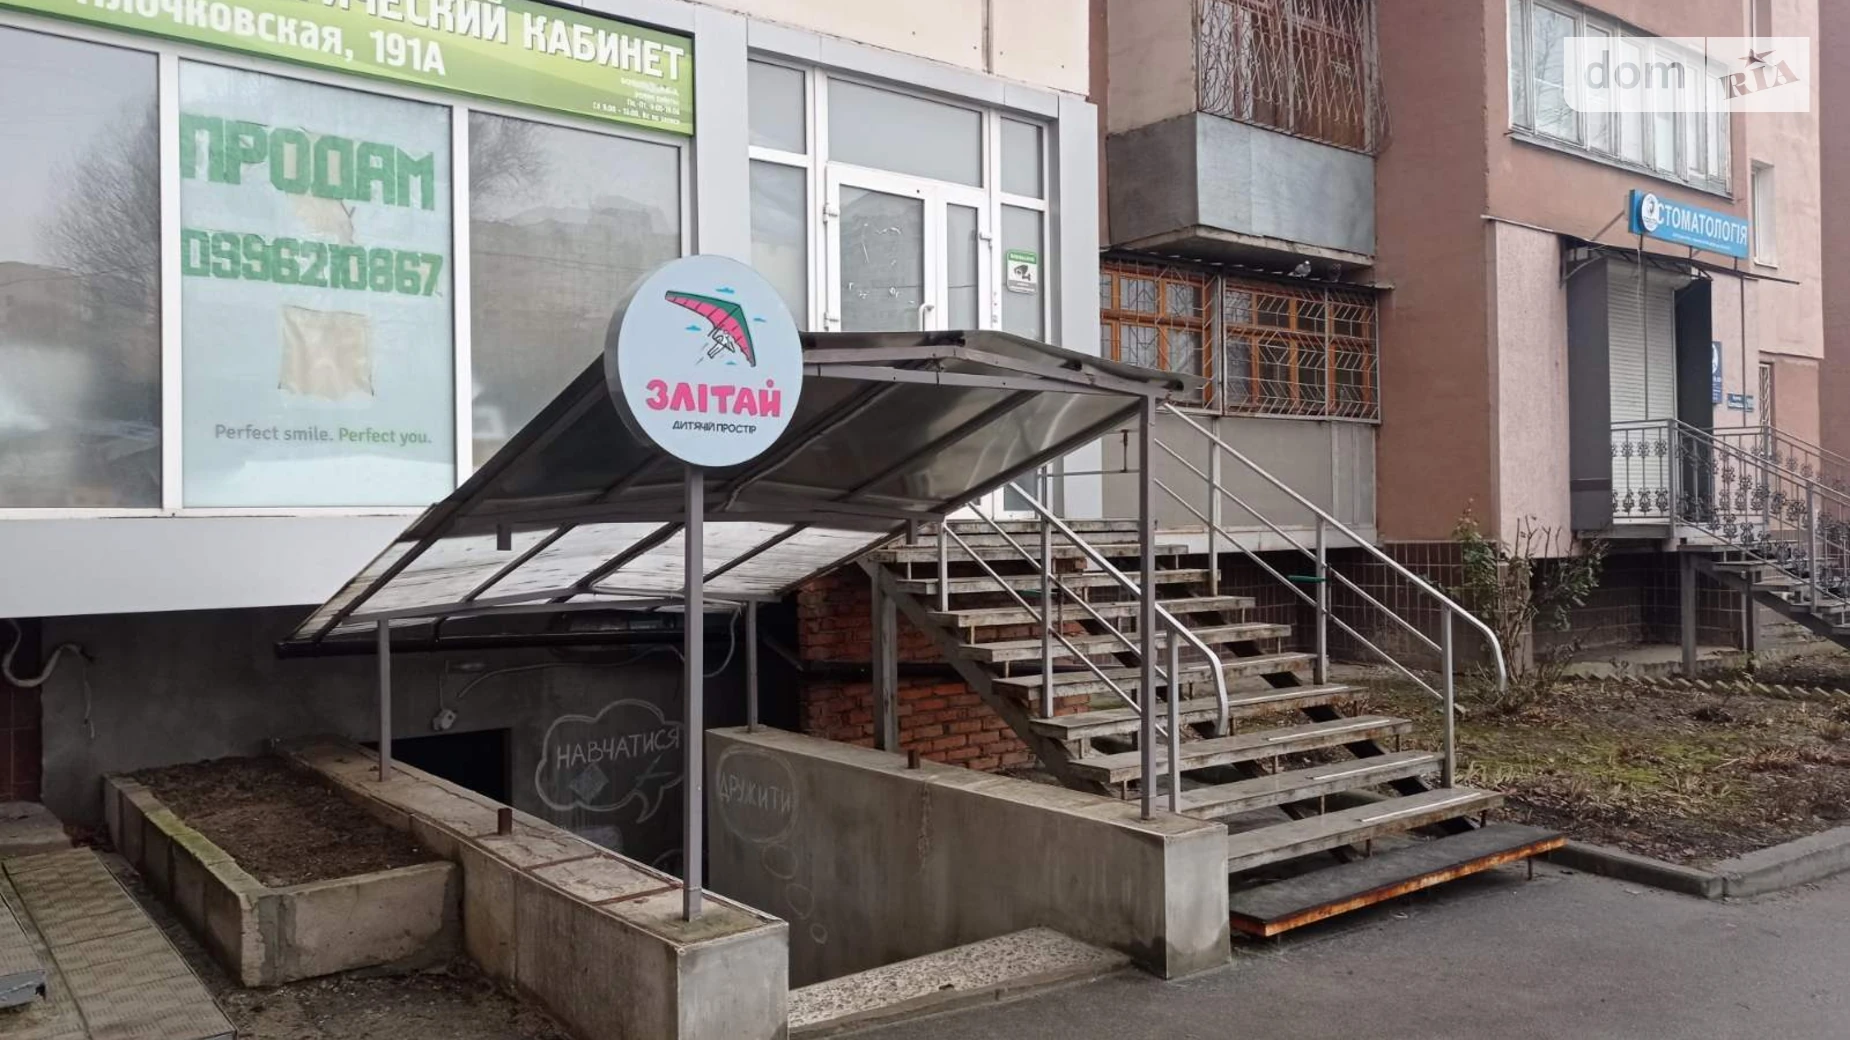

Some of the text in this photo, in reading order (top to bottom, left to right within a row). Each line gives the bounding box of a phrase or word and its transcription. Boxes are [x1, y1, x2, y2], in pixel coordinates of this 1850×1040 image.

[369, 30, 446, 76] 191А
[523, 12, 684, 80] КАБИНЕТ
[179, 112, 435, 210] ПРОДАМ
[1656, 202, 1748, 245] СТОМАТОЛОГІЯ
[181, 228, 443, 296] 0996210867
[645, 379, 782, 417] ЗЛІТАЙ
[215, 424, 432, 447] Perfect smile. Perfect you.
[556, 726, 680, 769] НАВЧАТИСЯ
[719, 771, 791, 814] ДРУЖИТИ
